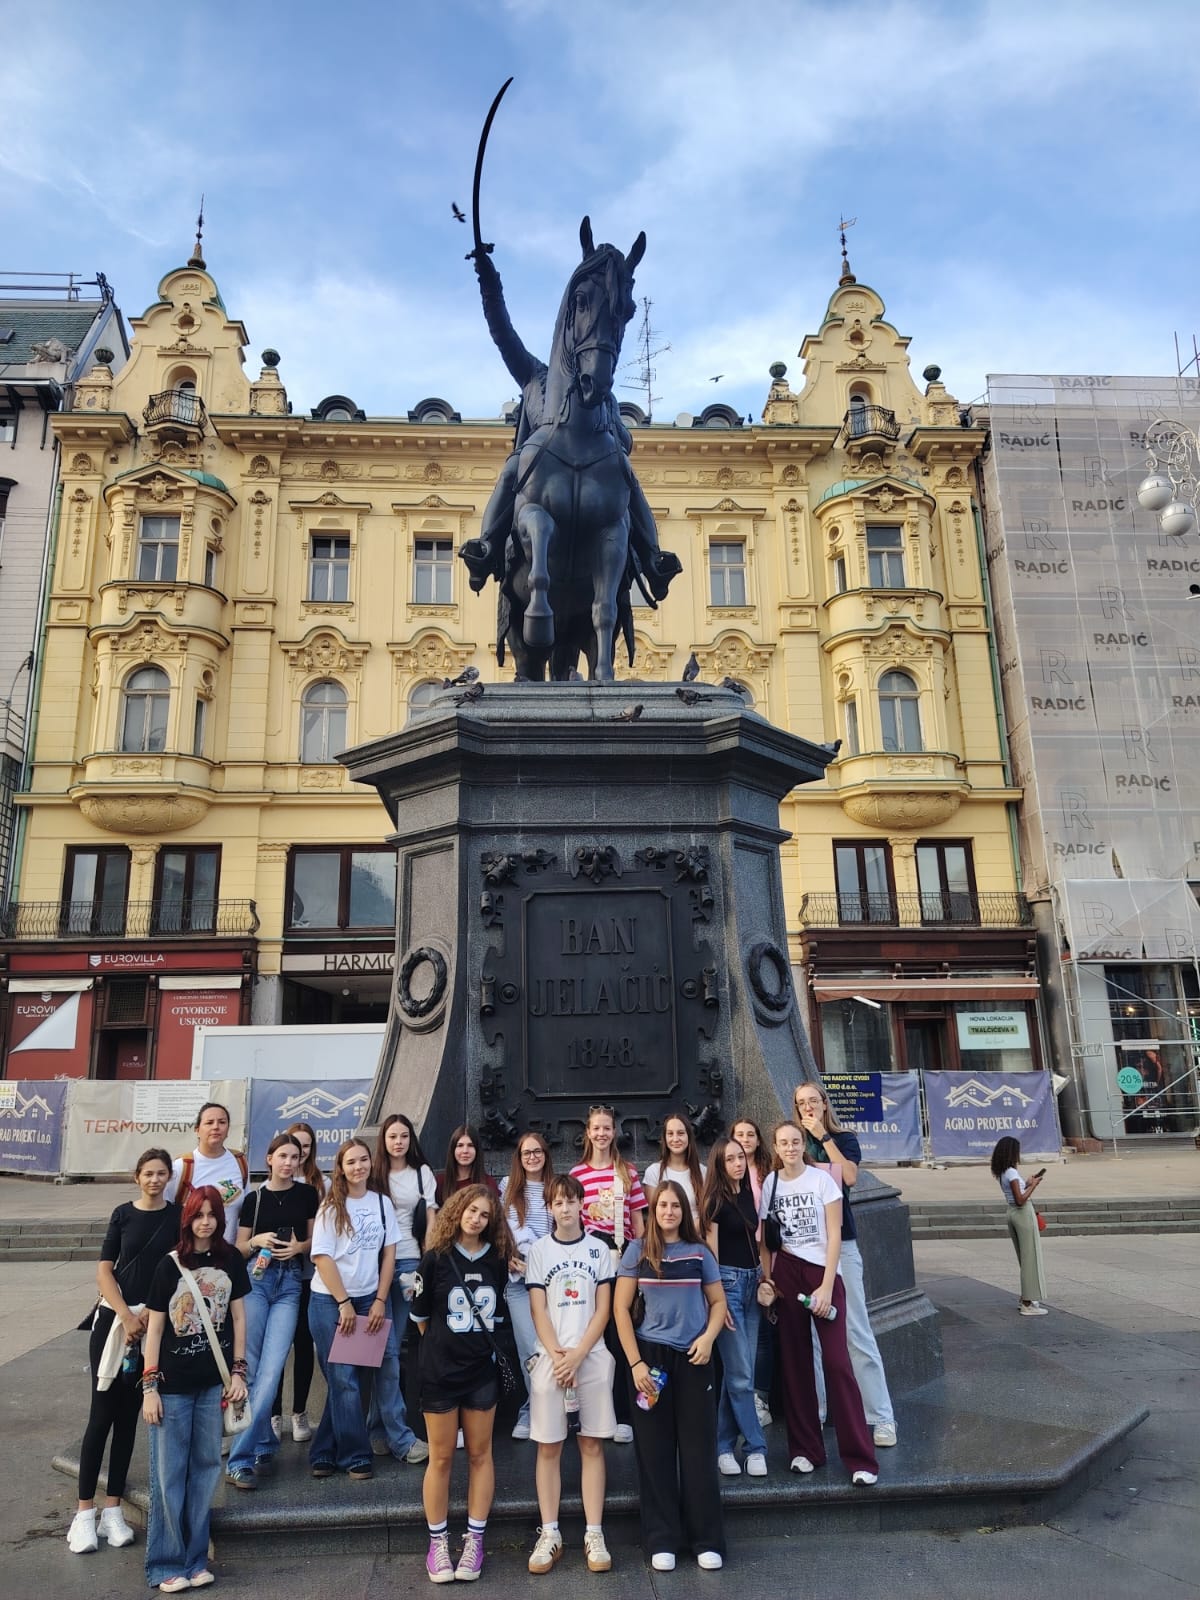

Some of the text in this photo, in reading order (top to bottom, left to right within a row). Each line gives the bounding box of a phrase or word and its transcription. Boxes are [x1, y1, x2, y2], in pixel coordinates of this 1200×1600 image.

[999, 431, 1051, 448] RADIĆ
[1071, 497, 1126, 512] RADIĆ
[1014, 559, 1069, 575] RADIĆ
[1146, 558, 1200, 573] RADIĆ
[1093, 631, 1149, 647] RADIĆ
[1031, 695, 1087, 711] RADIĆ
[1115, 775, 1172, 792] RADIĆ
[1052, 841, 1107, 857] RADIĆ
[560, 917, 638, 957] BAN
[104, 953, 165, 964] EUROVILLA
[529, 962, 673, 1017] JELAČIĆ
[171, 1005, 228, 1015] OTVORENJE
[179, 1017, 219, 1026] USKORO
[872, 1121, 901, 1134] d.o.o.
[944, 1116, 1039, 1133] AGRAD PROJEKT d.o.o.
[11, 1129, 37, 1145] PROJEKT
[446, 1285, 497, 1333] 92
